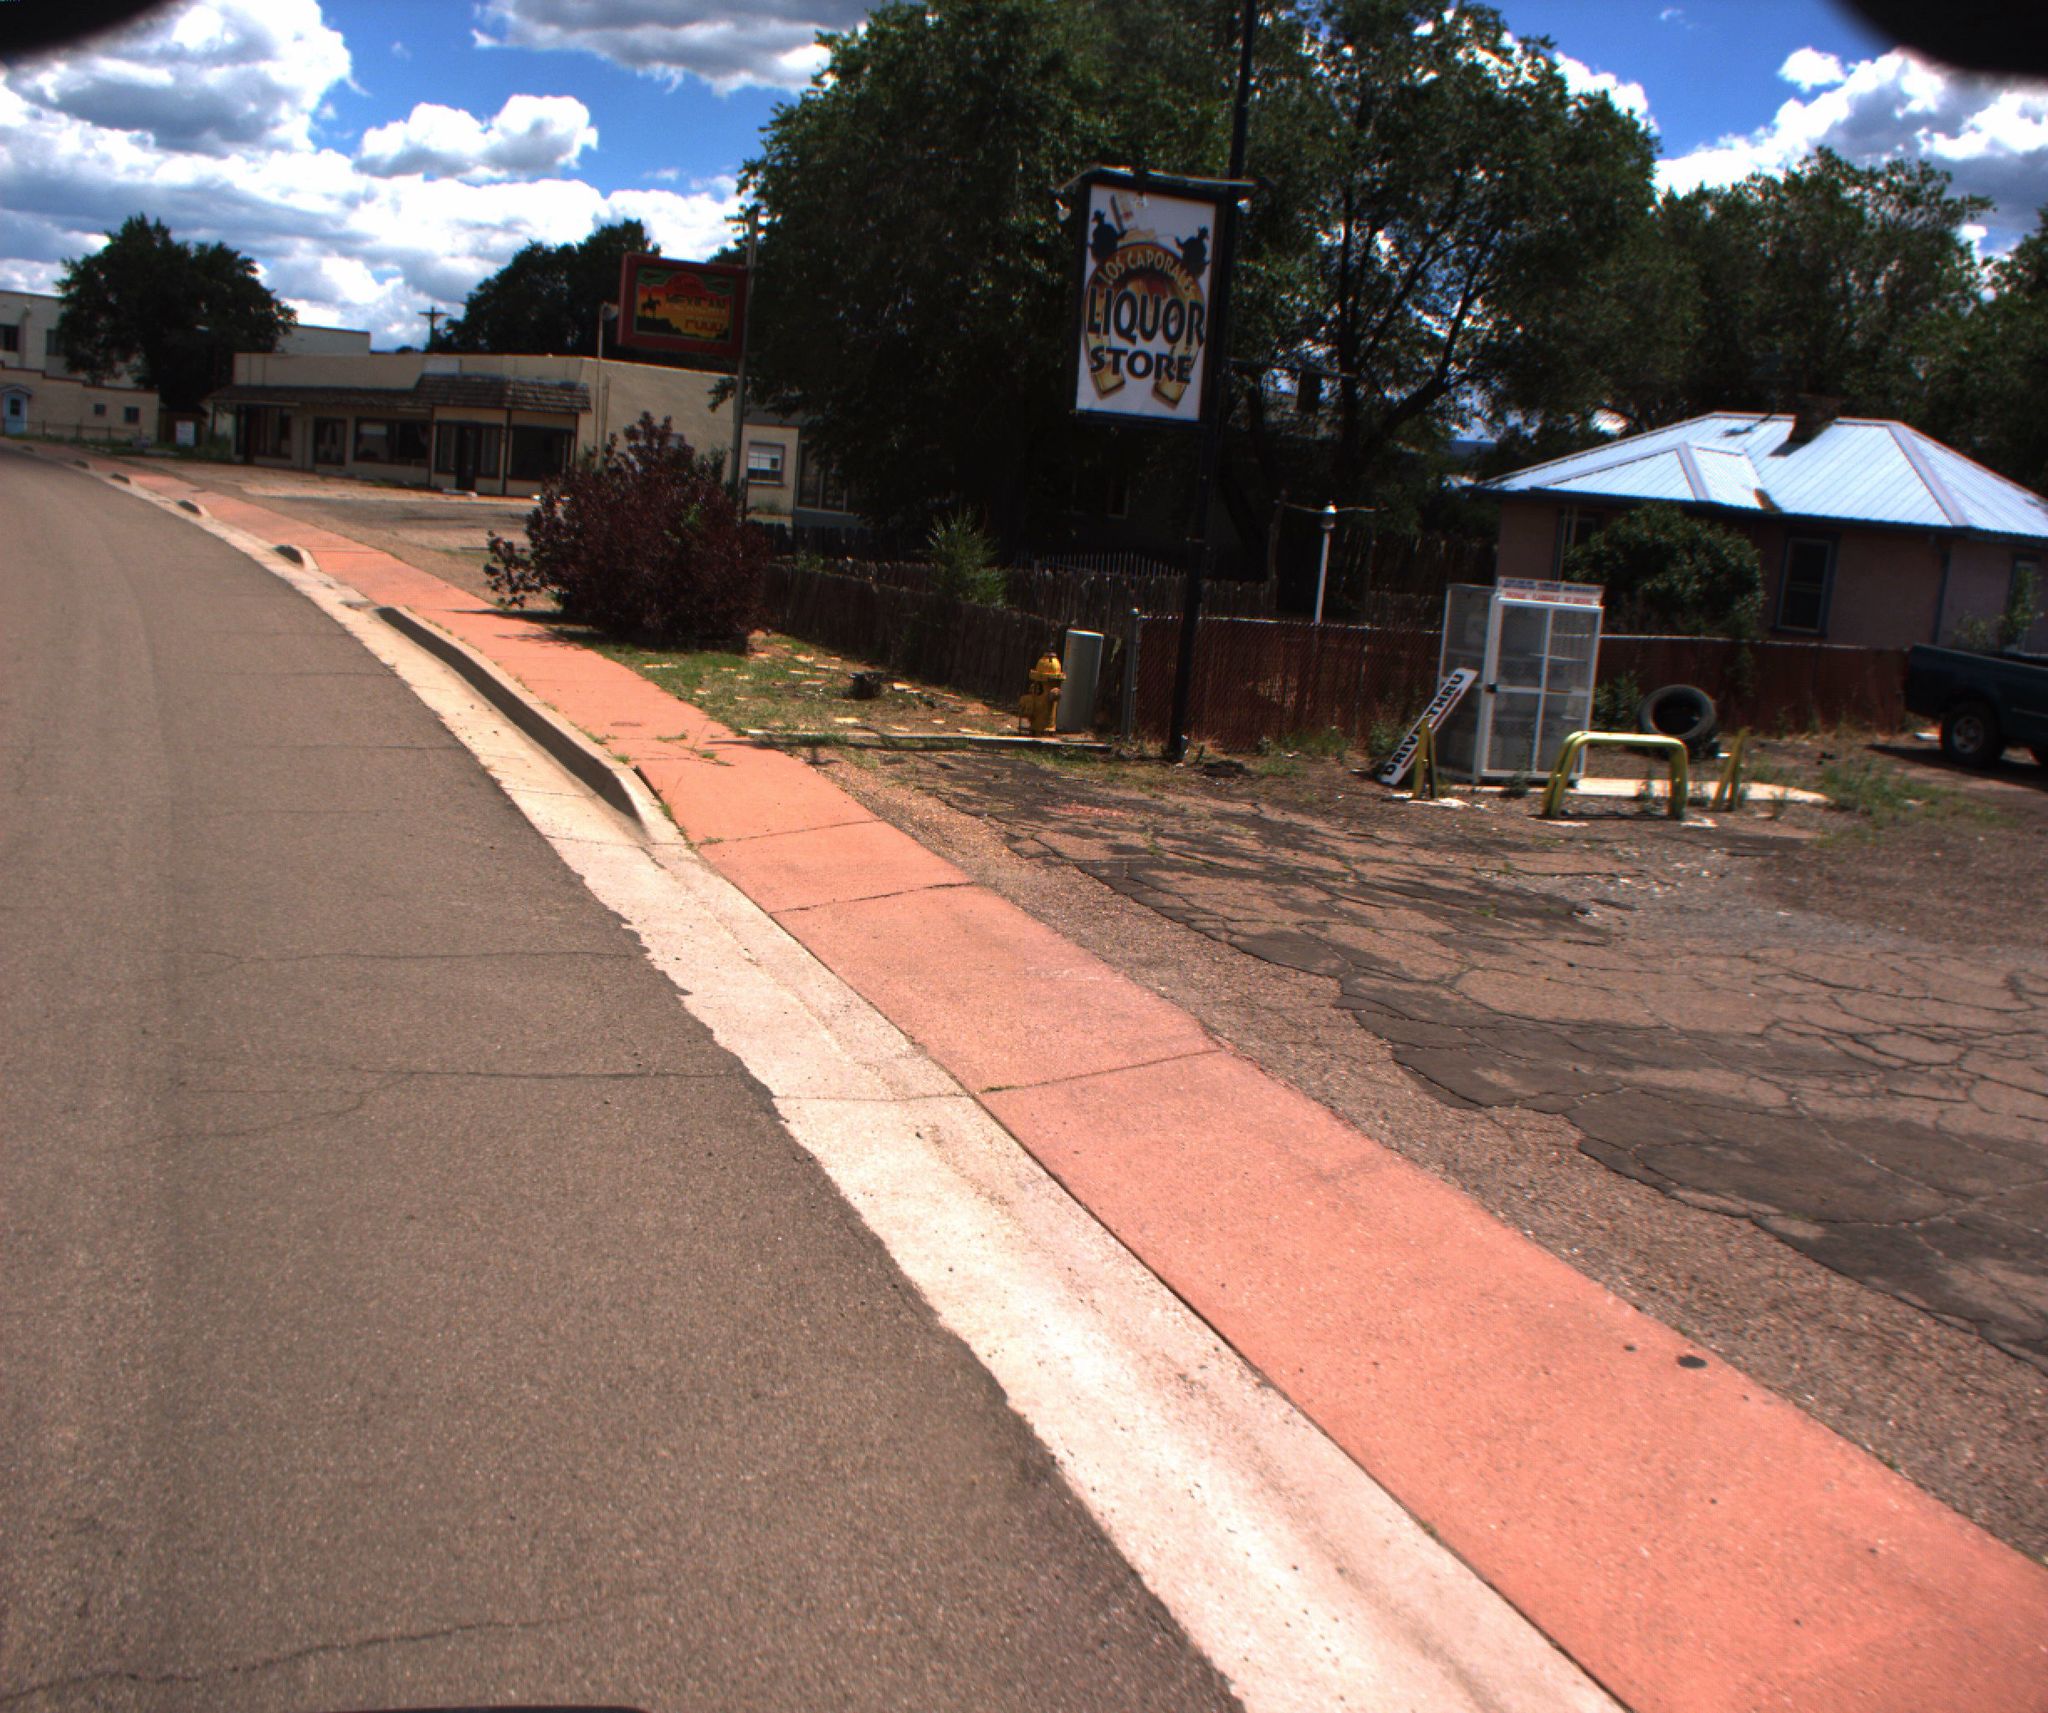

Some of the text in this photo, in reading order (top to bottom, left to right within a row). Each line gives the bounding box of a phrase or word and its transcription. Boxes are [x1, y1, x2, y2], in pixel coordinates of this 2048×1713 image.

[1096, 257, 1126, 286] LOS
[665, 293, 726, 309] MEXICAN
[1086, 287, 1206, 346] LIQUOR
[684, 317, 724, 333] FOOD
[1089, 346, 1193, 384] STORE
[1428, 673, 1466, 717] THRU
